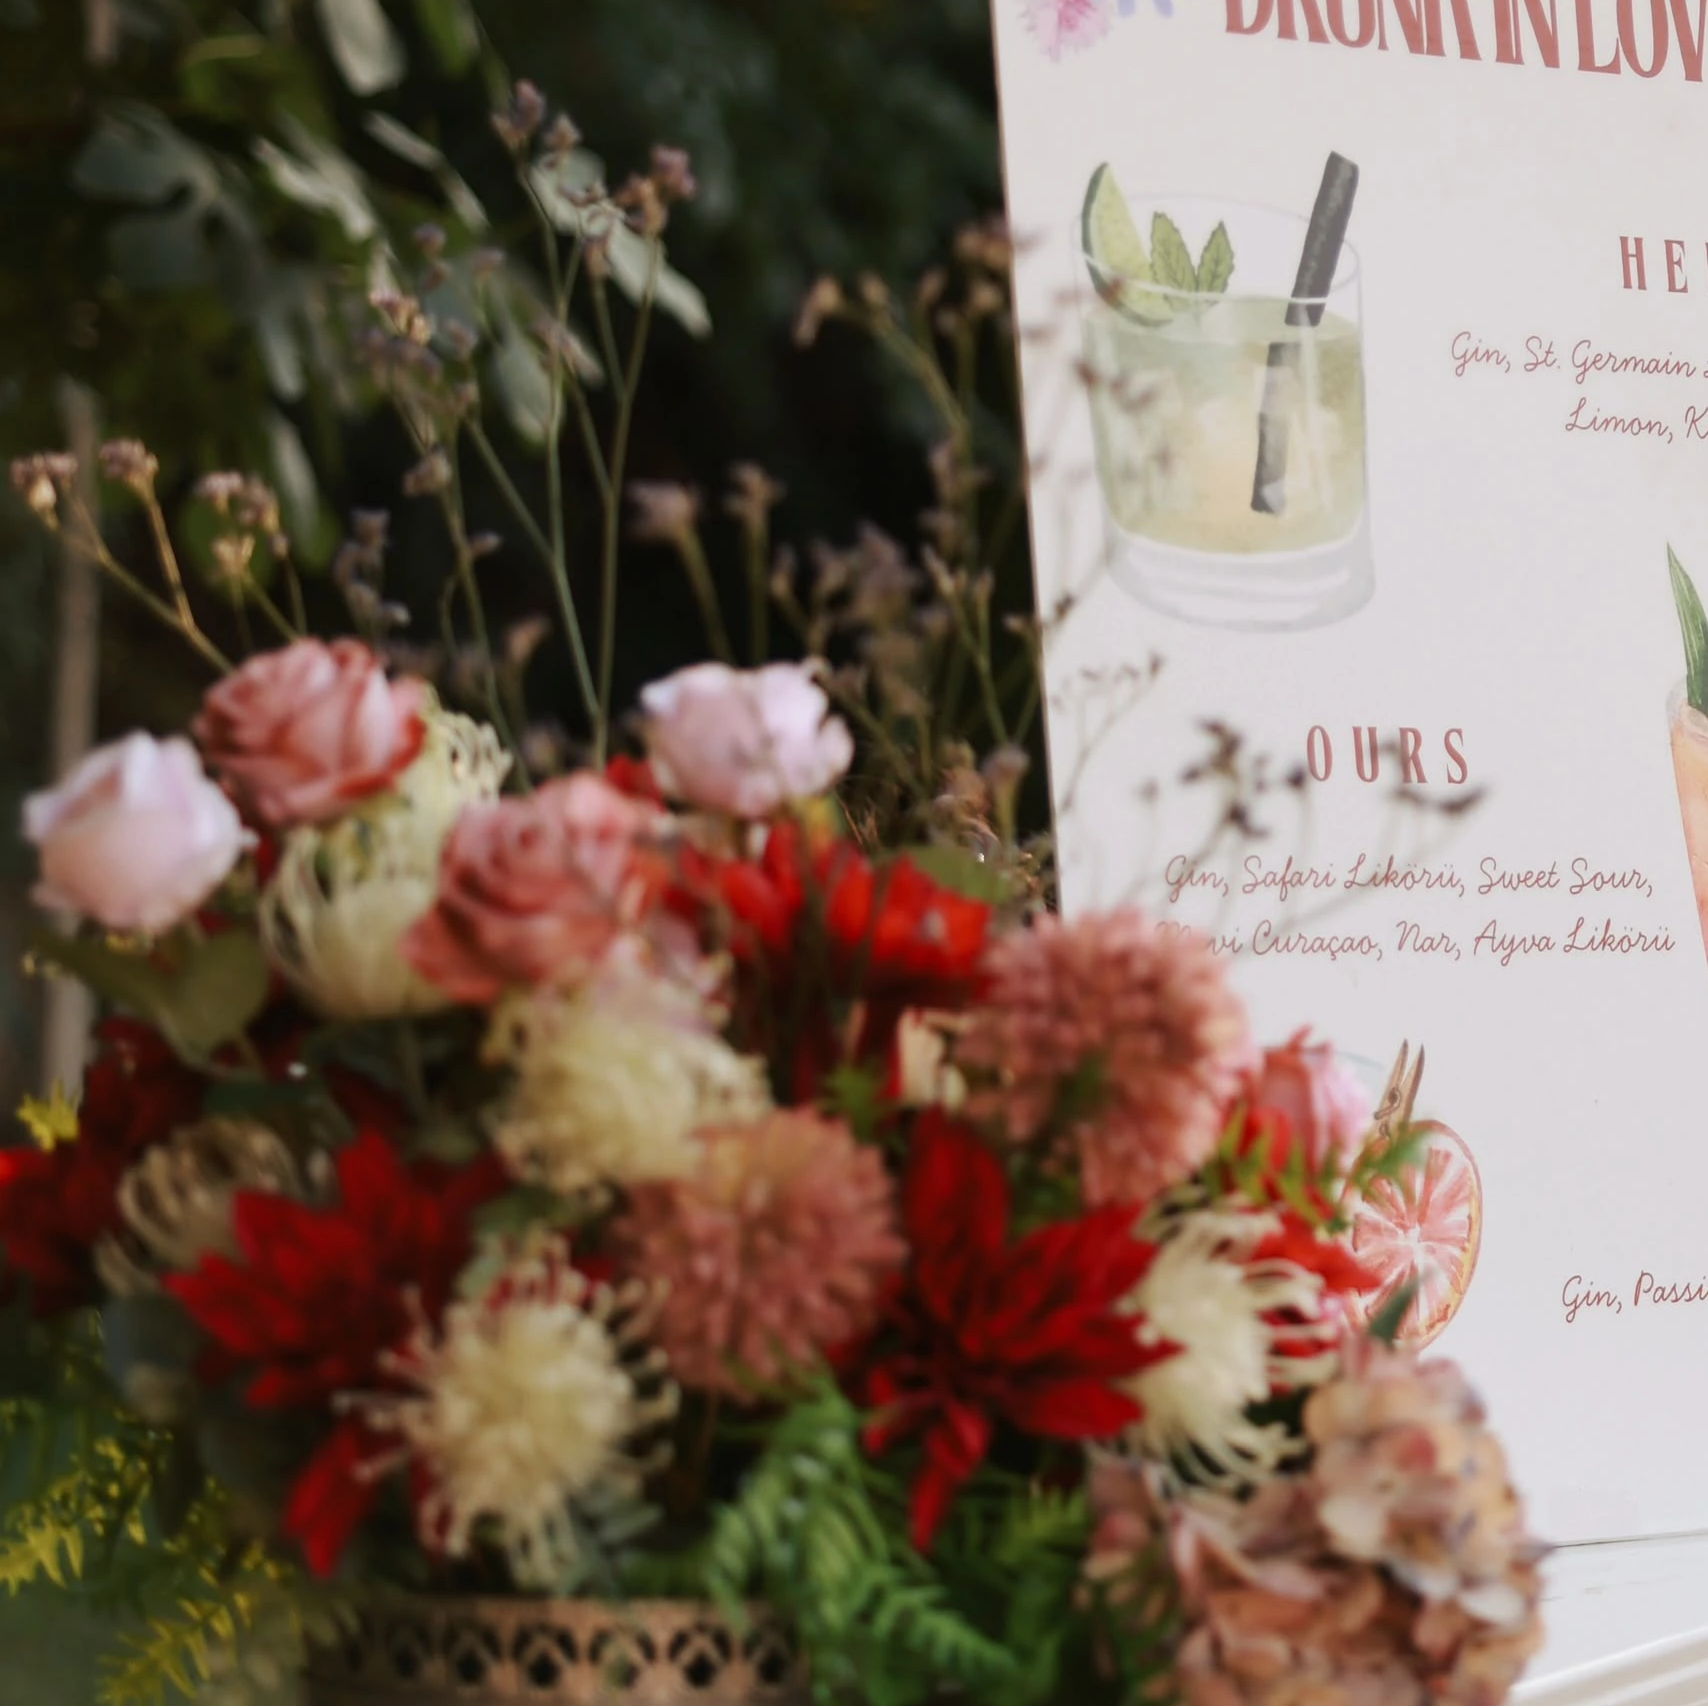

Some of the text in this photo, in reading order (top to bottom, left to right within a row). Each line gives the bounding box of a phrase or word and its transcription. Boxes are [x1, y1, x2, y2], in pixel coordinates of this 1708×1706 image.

[1451, 331, 1511, 377] Gin,
[1523, 335, 1561, 371] St.
[1571, 339, 1697, 384] Germain
[1564, 397, 1674, 444] Limon,
[1306, 724, 1469, 785] OURS
[1165, 853, 1653, 902] Gin, Safari Likörü, Sweet Sour,
[1155, 916, 1676, 966] Mvi Curaçao, Nar, Ayva Likörü
[1562, 1275, 1623, 1323] Gin,
